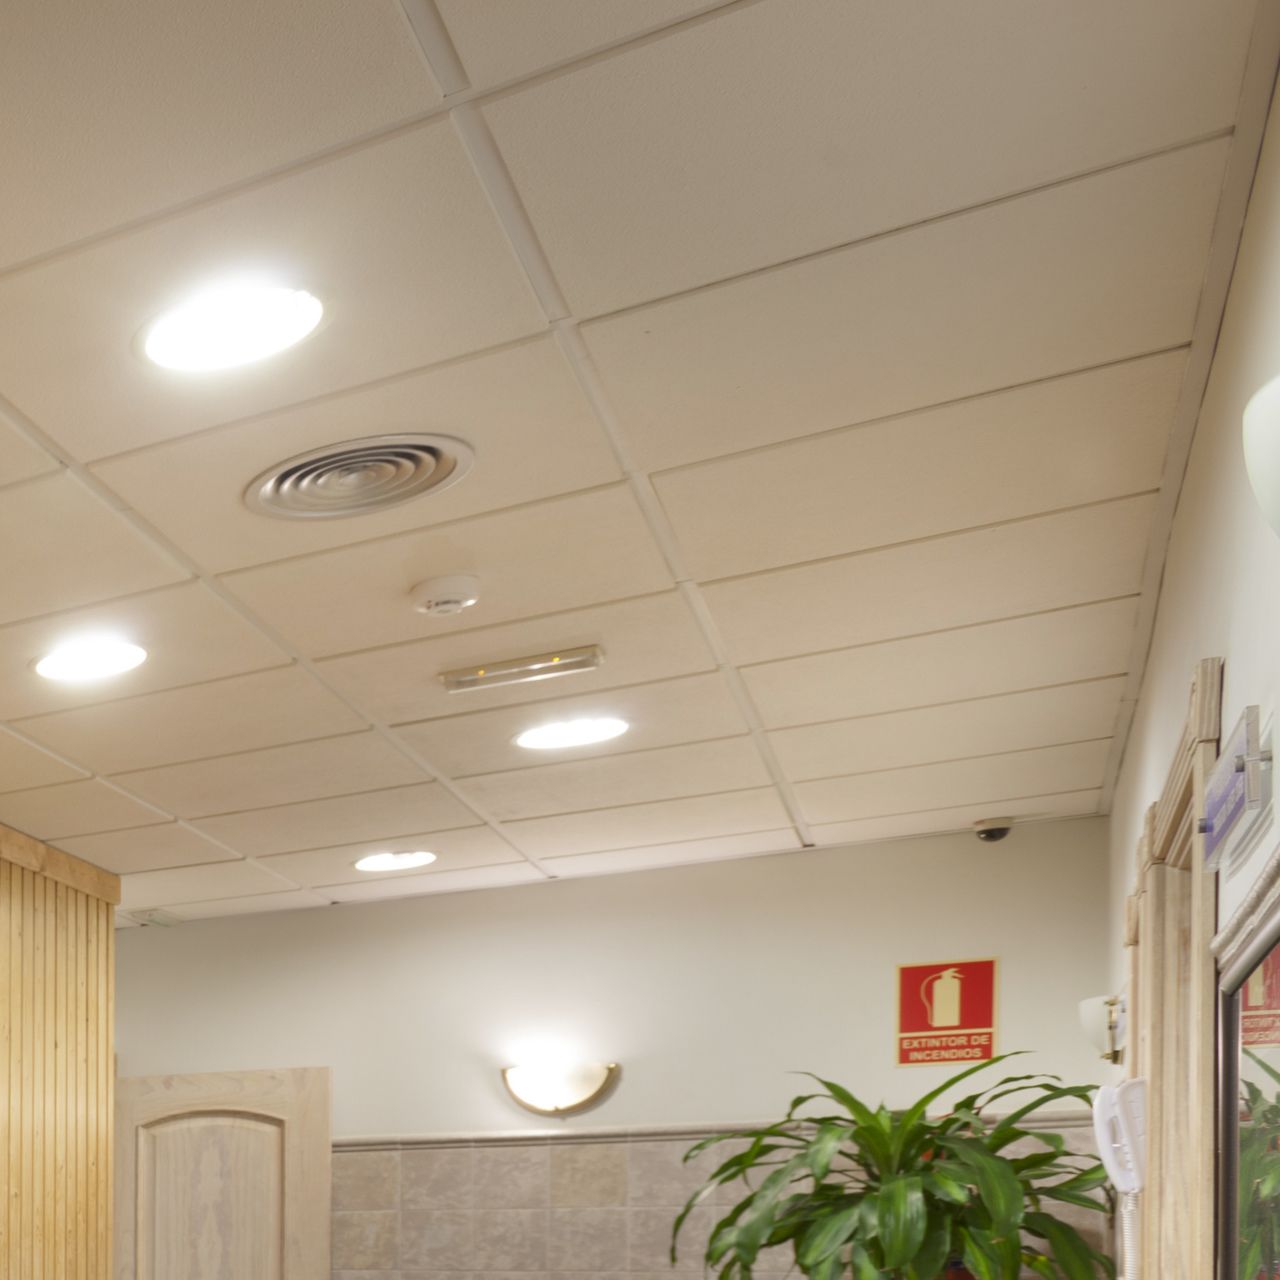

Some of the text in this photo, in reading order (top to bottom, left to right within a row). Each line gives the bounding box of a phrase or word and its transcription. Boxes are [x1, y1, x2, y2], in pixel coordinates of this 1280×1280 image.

[902, 1035, 990, 1049] EXTINTOR DE
[909, 1048, 982, 1060] INCENDIOS
